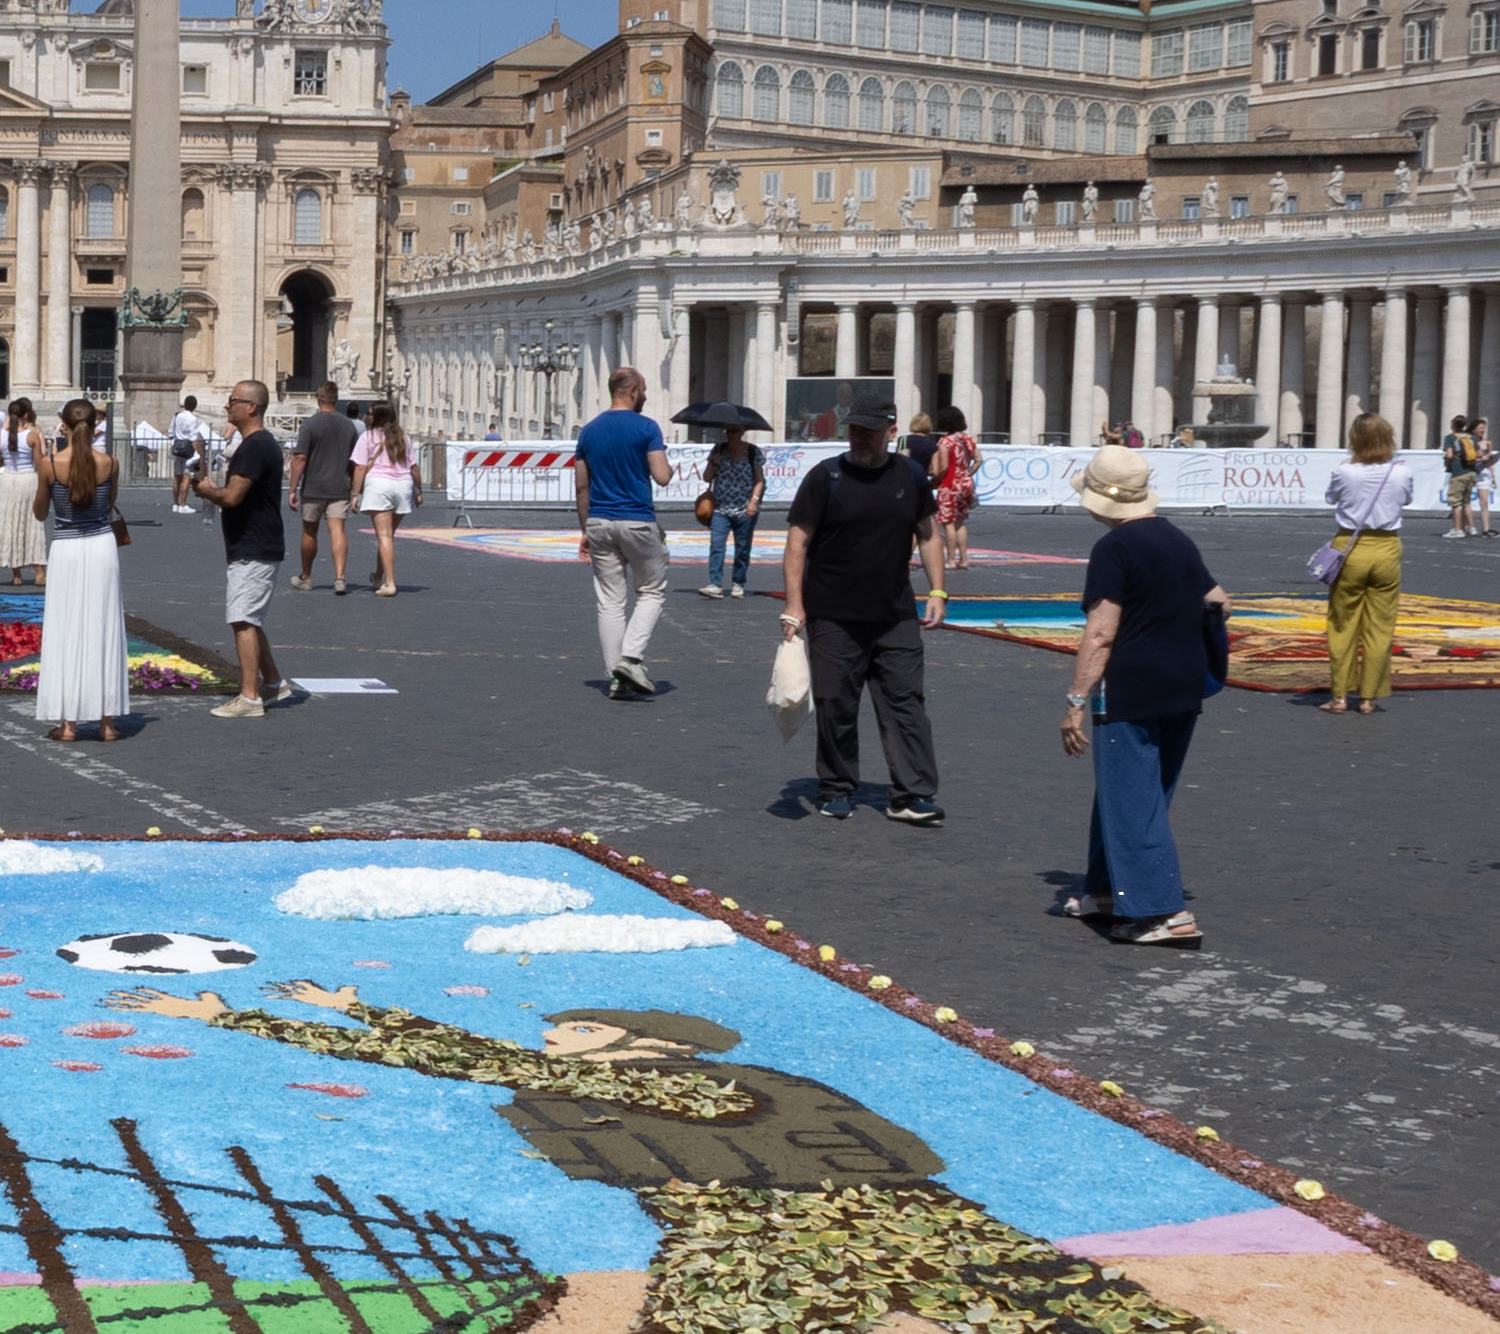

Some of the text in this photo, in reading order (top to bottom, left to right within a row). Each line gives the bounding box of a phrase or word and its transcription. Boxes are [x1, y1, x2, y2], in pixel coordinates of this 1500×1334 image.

[668, 447, 705, 459] OCO
[1223, 452, 1307, 466] PRO LOCO
[1223, 466, 1306, 488] ROMA
[1221, 489, 1307, 505] CAPITALE
